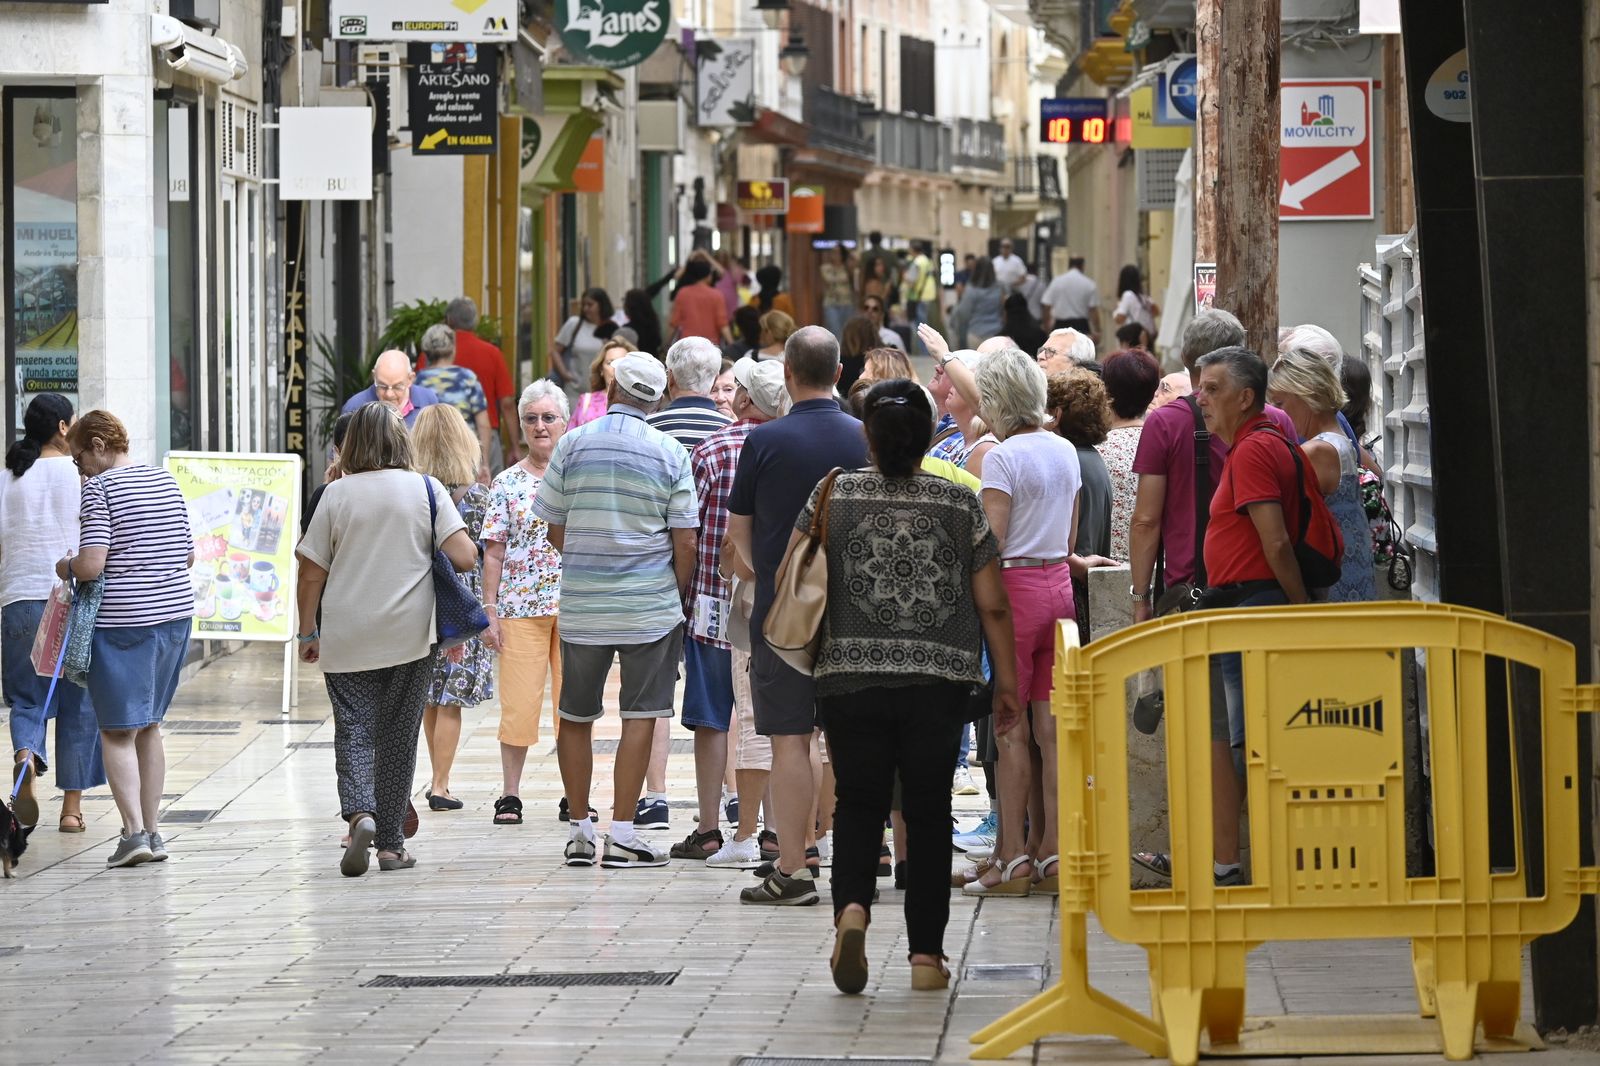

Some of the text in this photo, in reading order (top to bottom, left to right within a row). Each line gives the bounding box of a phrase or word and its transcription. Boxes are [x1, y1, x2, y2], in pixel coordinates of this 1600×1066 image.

[419, 64, 433, 74] EL
[418, 72, 490, 88] ARTESANO
[455, 93, 460, 101] y
[1443, 90, 1467, 100] 902
[435, 102, 474, 111] del calzado
[468, 113, 482, 124] piel
[1048, 118, 1104, 142] 10 10
[1284, 126, 1355, 138] MOVILCITY
[447, 136, 458, 145] EN
[16, 228, 34, 240] MI
[26, 367, 49, 377] funda
[60, 382, 78, 390] MOV
[286, 291, 304, 472] ZAPATER
[176, 464, 286, 478] PEONLIZACIÓN
